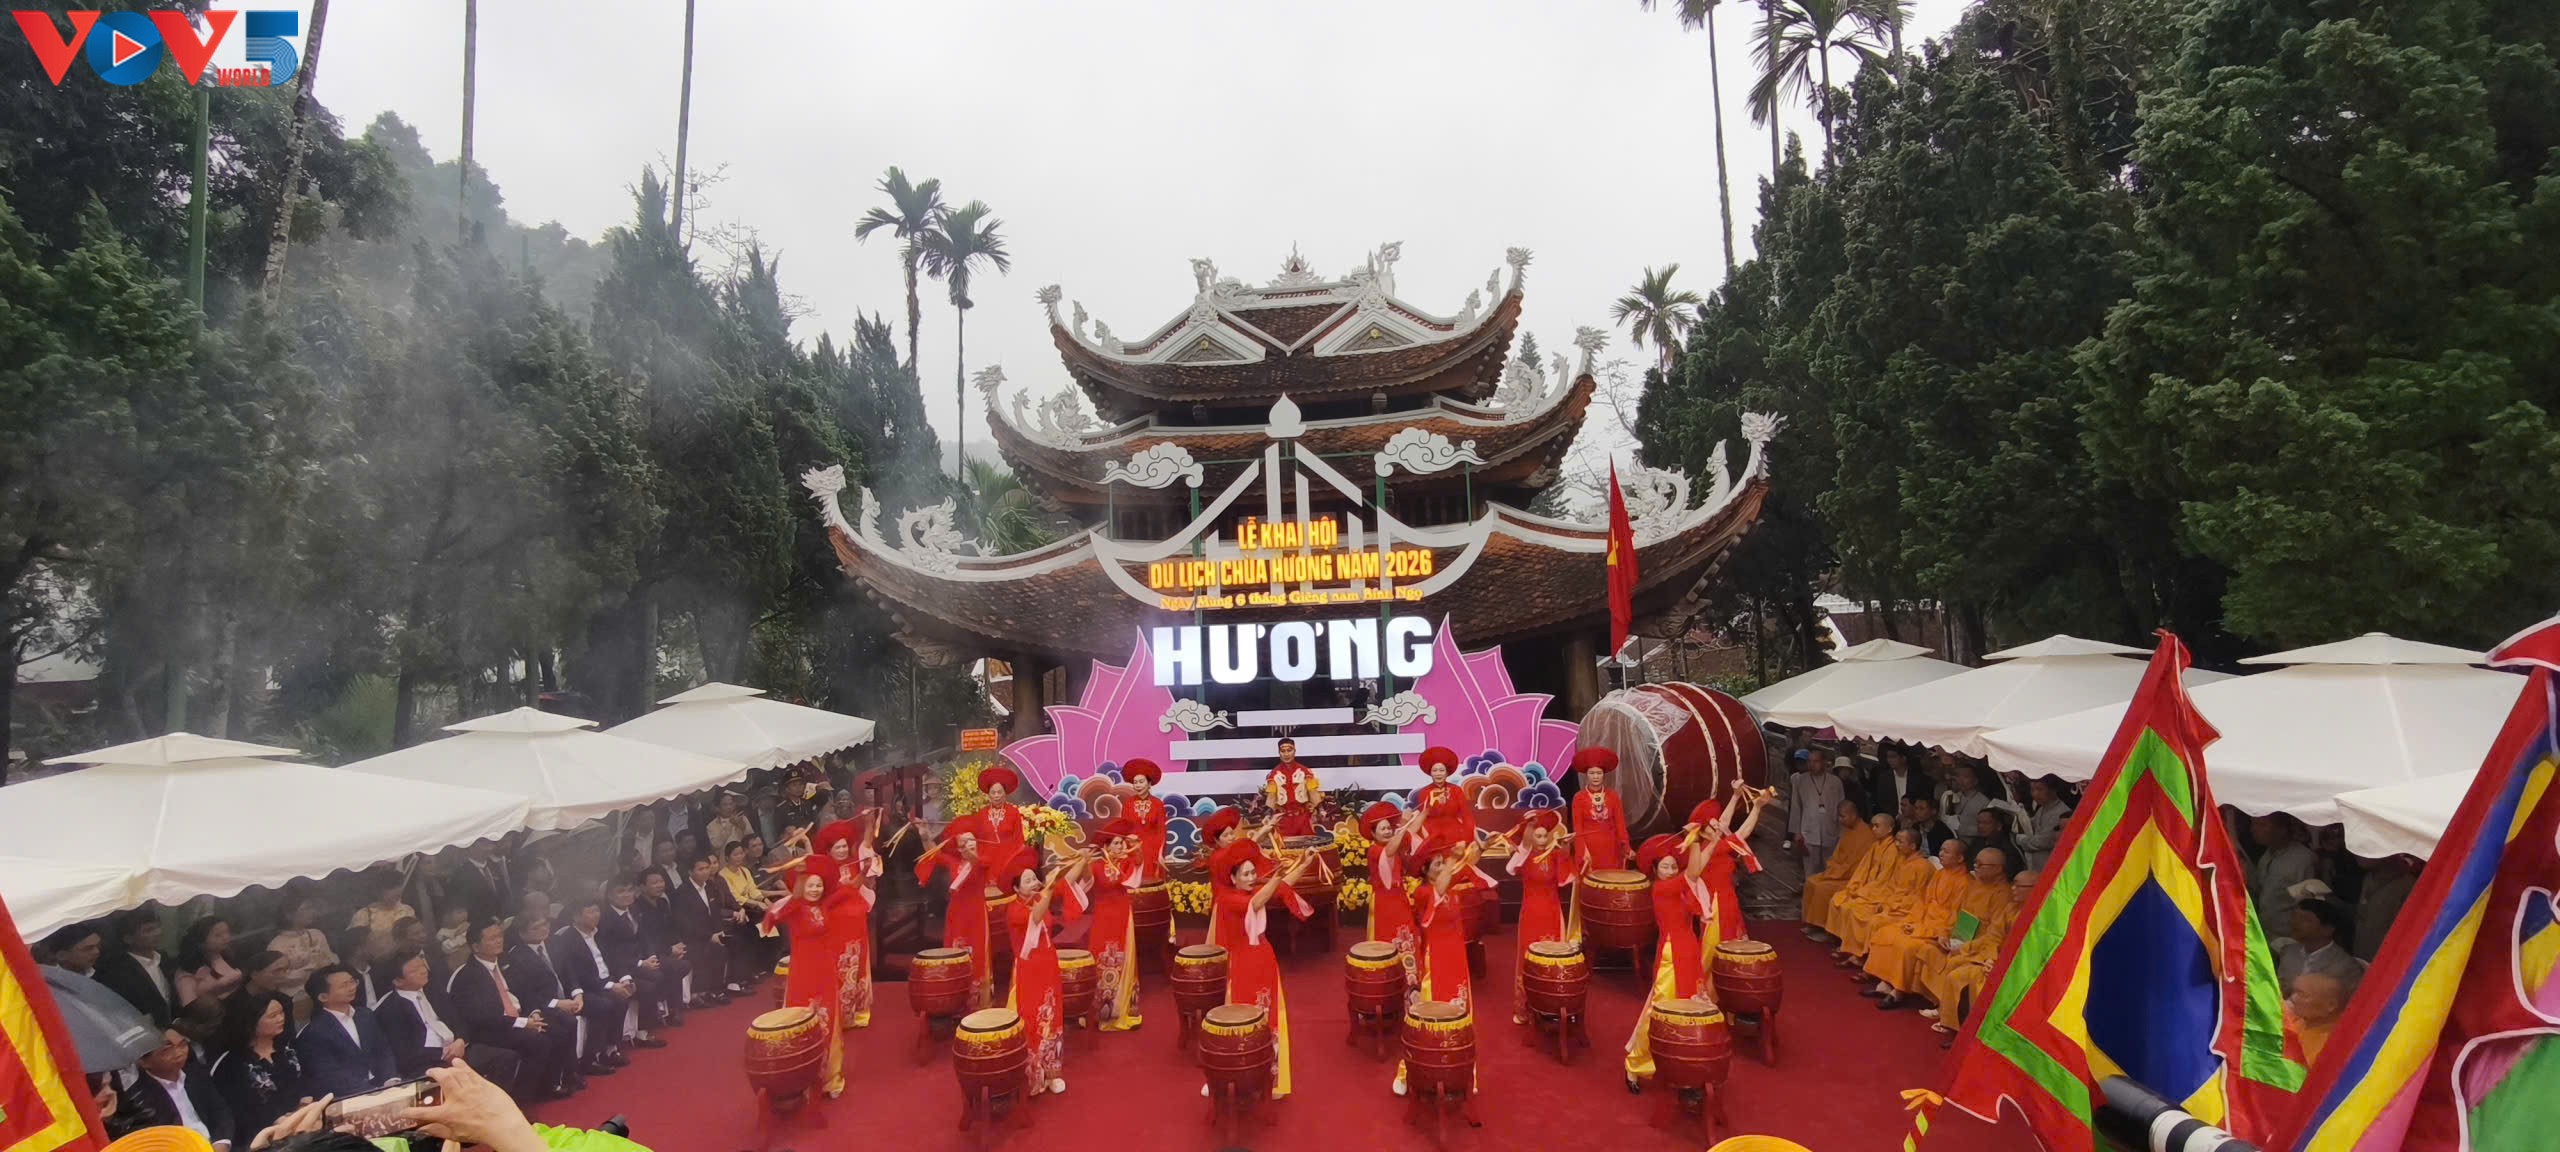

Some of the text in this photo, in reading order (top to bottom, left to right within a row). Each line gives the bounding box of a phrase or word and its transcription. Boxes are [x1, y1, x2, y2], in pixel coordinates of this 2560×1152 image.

[1238, 516, 1338, 550] LỄ KHAI HỘI
[1150, 549, 1432, 591] DU LỊCH CHÙA HƯƠNG NĂM 2026
[1235, 593, 1246, 606] 6
[1153, 616, 1433, 686] HƯƠNG
